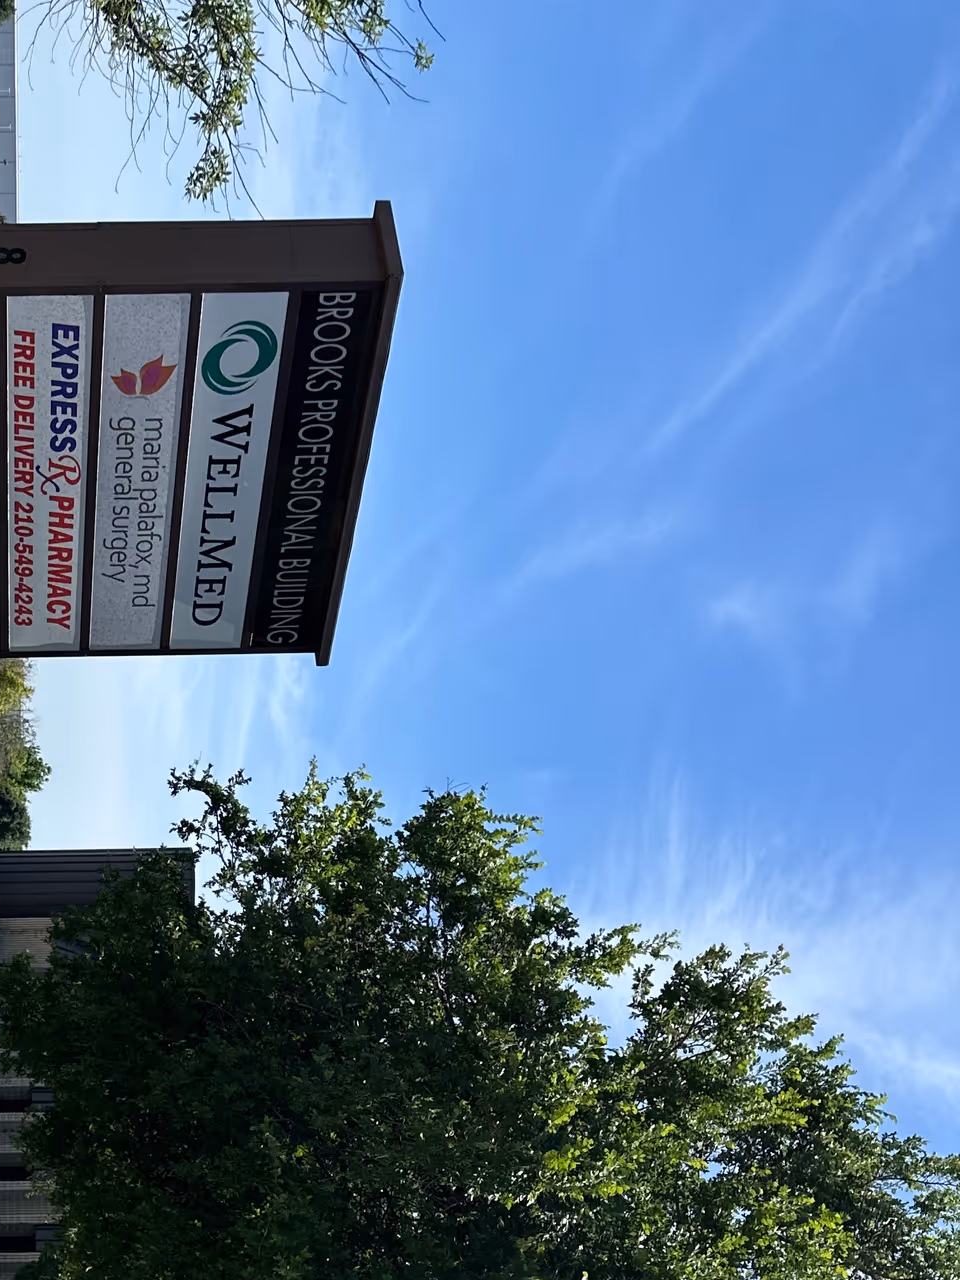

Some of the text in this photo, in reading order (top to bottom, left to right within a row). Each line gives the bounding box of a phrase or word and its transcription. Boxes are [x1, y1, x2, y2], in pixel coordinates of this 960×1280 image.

[49, 322, 80, 453] EXPRESS
[266, 292, 357, 644] BROOKS PROFESSIONAL BUILDING
[13, 329, 36, 627] FREE DELIVERY 210-549-4243
[46, 495, 75, 630] PHARMACY
[102, 417, 139, 583] general surgery
[129, 417, 166, 607] maria palafox, md
